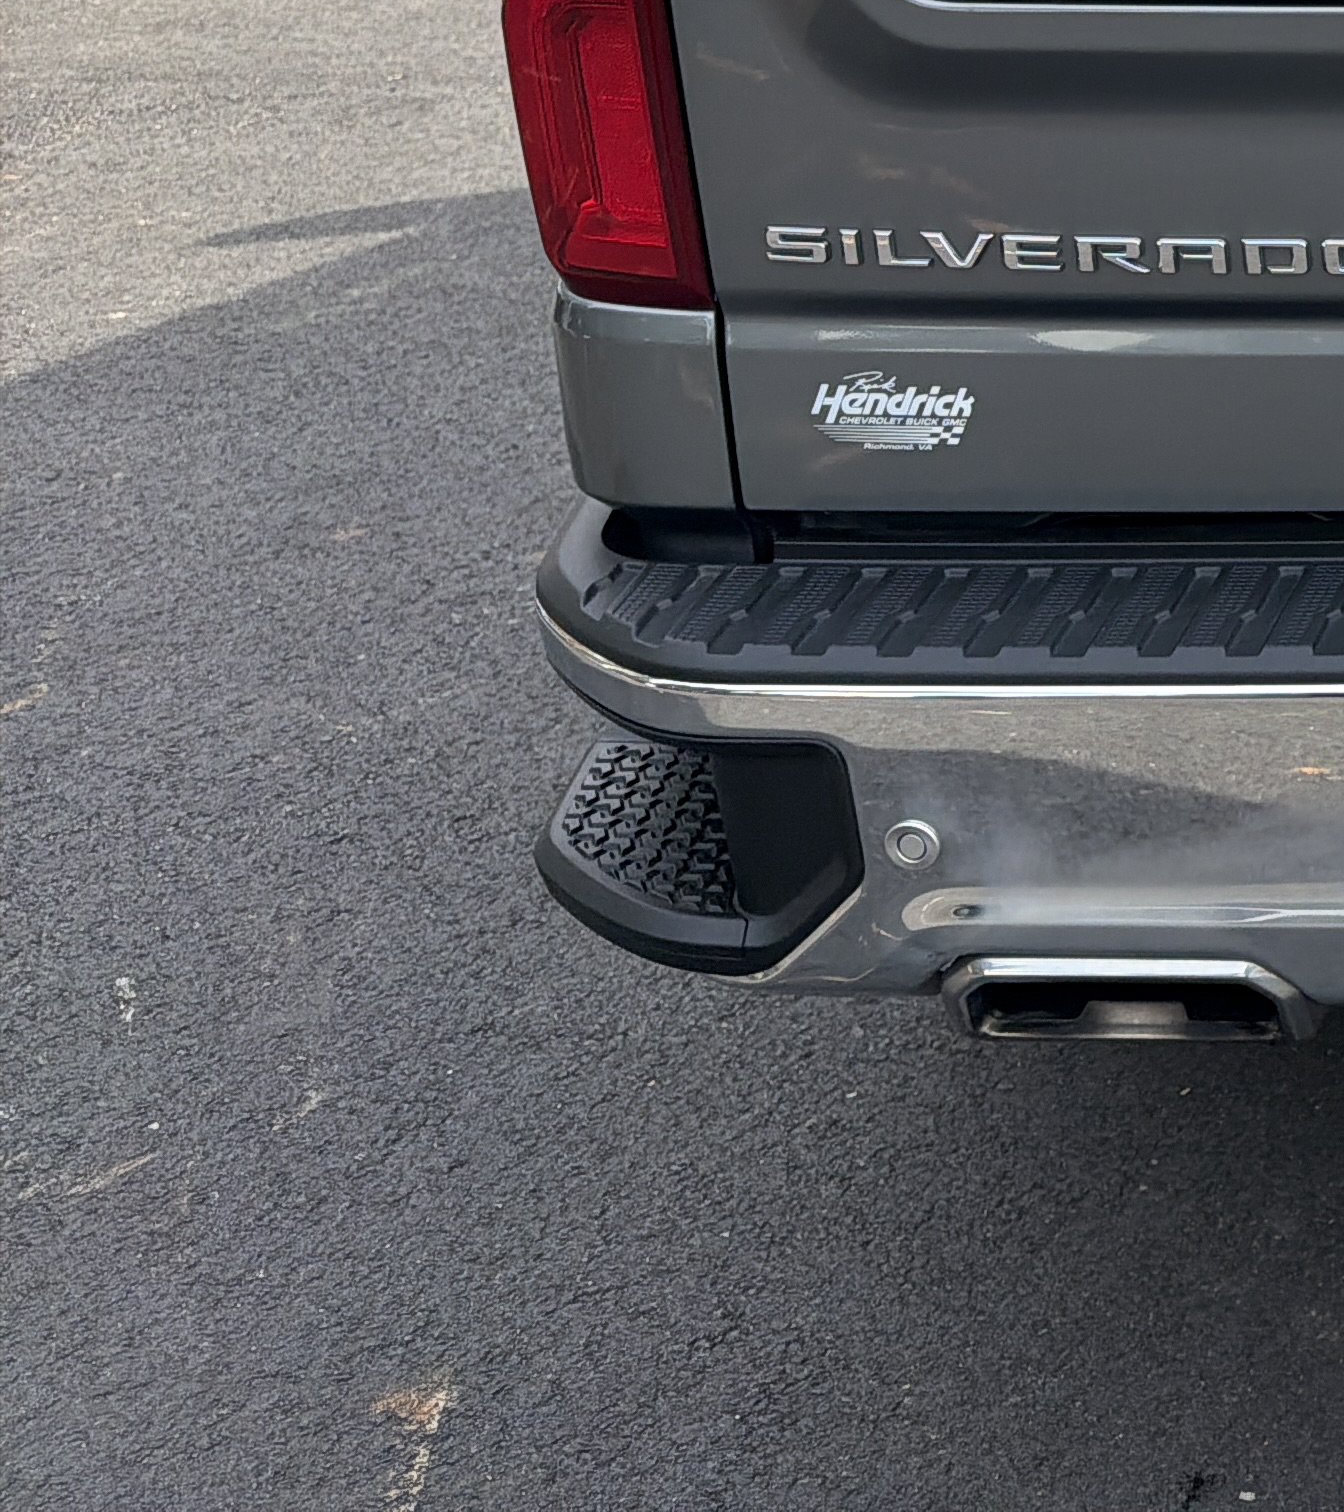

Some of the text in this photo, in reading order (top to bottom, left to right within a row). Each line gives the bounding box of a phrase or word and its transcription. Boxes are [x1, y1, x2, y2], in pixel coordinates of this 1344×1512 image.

[811, 383, 975, 424] Hendrick
[838, 416, 968, 427] CHEVROLET BUICK GMC
